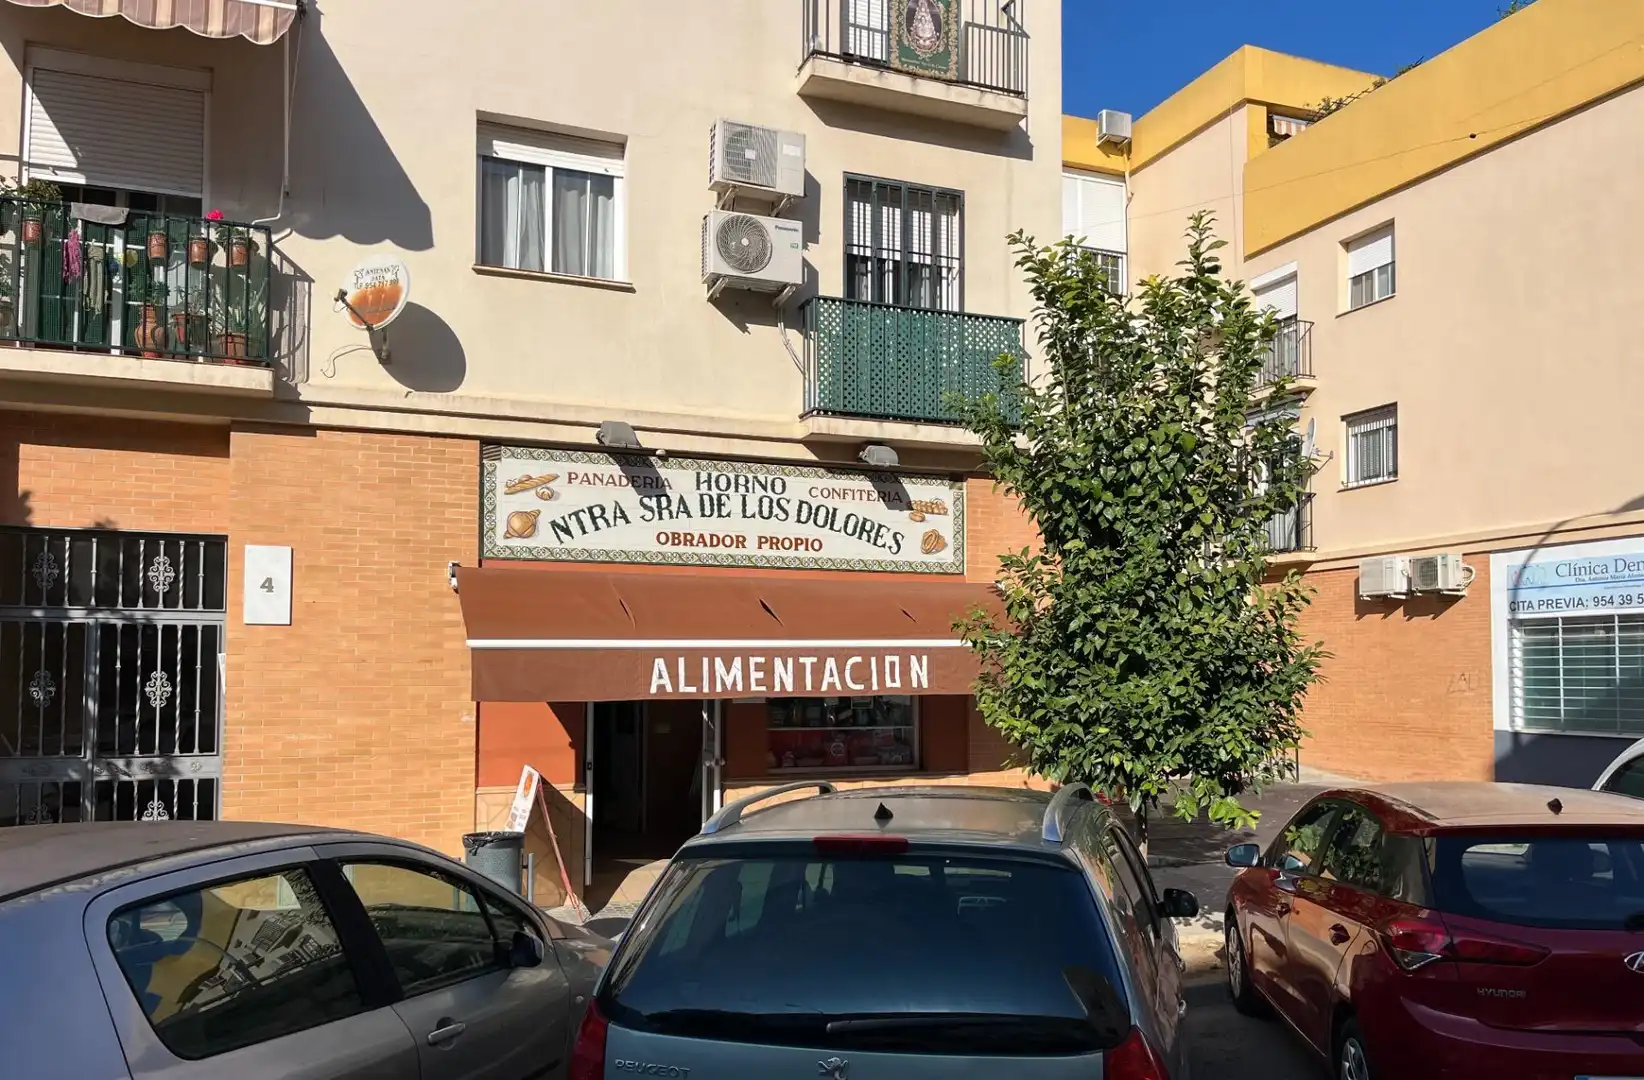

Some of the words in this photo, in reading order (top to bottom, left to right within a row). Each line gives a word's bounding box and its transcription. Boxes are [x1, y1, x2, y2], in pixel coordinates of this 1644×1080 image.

[567, 472, 673, 490] PANADERIA
[696, 472, 787, 495] HORNO
[808, 486, 903, 503] CONFITERIA
[549, 500, 631, 545] NTRA
[639, 493, 693, 522] SRA
[699, 493, 732, 518] DE
[740, 494, 791, 522] LOS
[795, 499, 905, 555] DOLORES
[656, 531, 747, 549] OBRADOR
[757, 535, 823, 552] PROPIO
[1555, 561, 1609, 578] Clínica
[260, 577, 274, 593] 4
[1509, 600, 1534, 612] CITA
[1538, 597, 1589, 610] PREVIA:
[1593, 595, 1614, 607] 954
[1618, 594, 1633, 605] 39
[650, 655, 928, 693] ALIMENTACION
[615, 1059, 692, 1079] PEUGEOT
